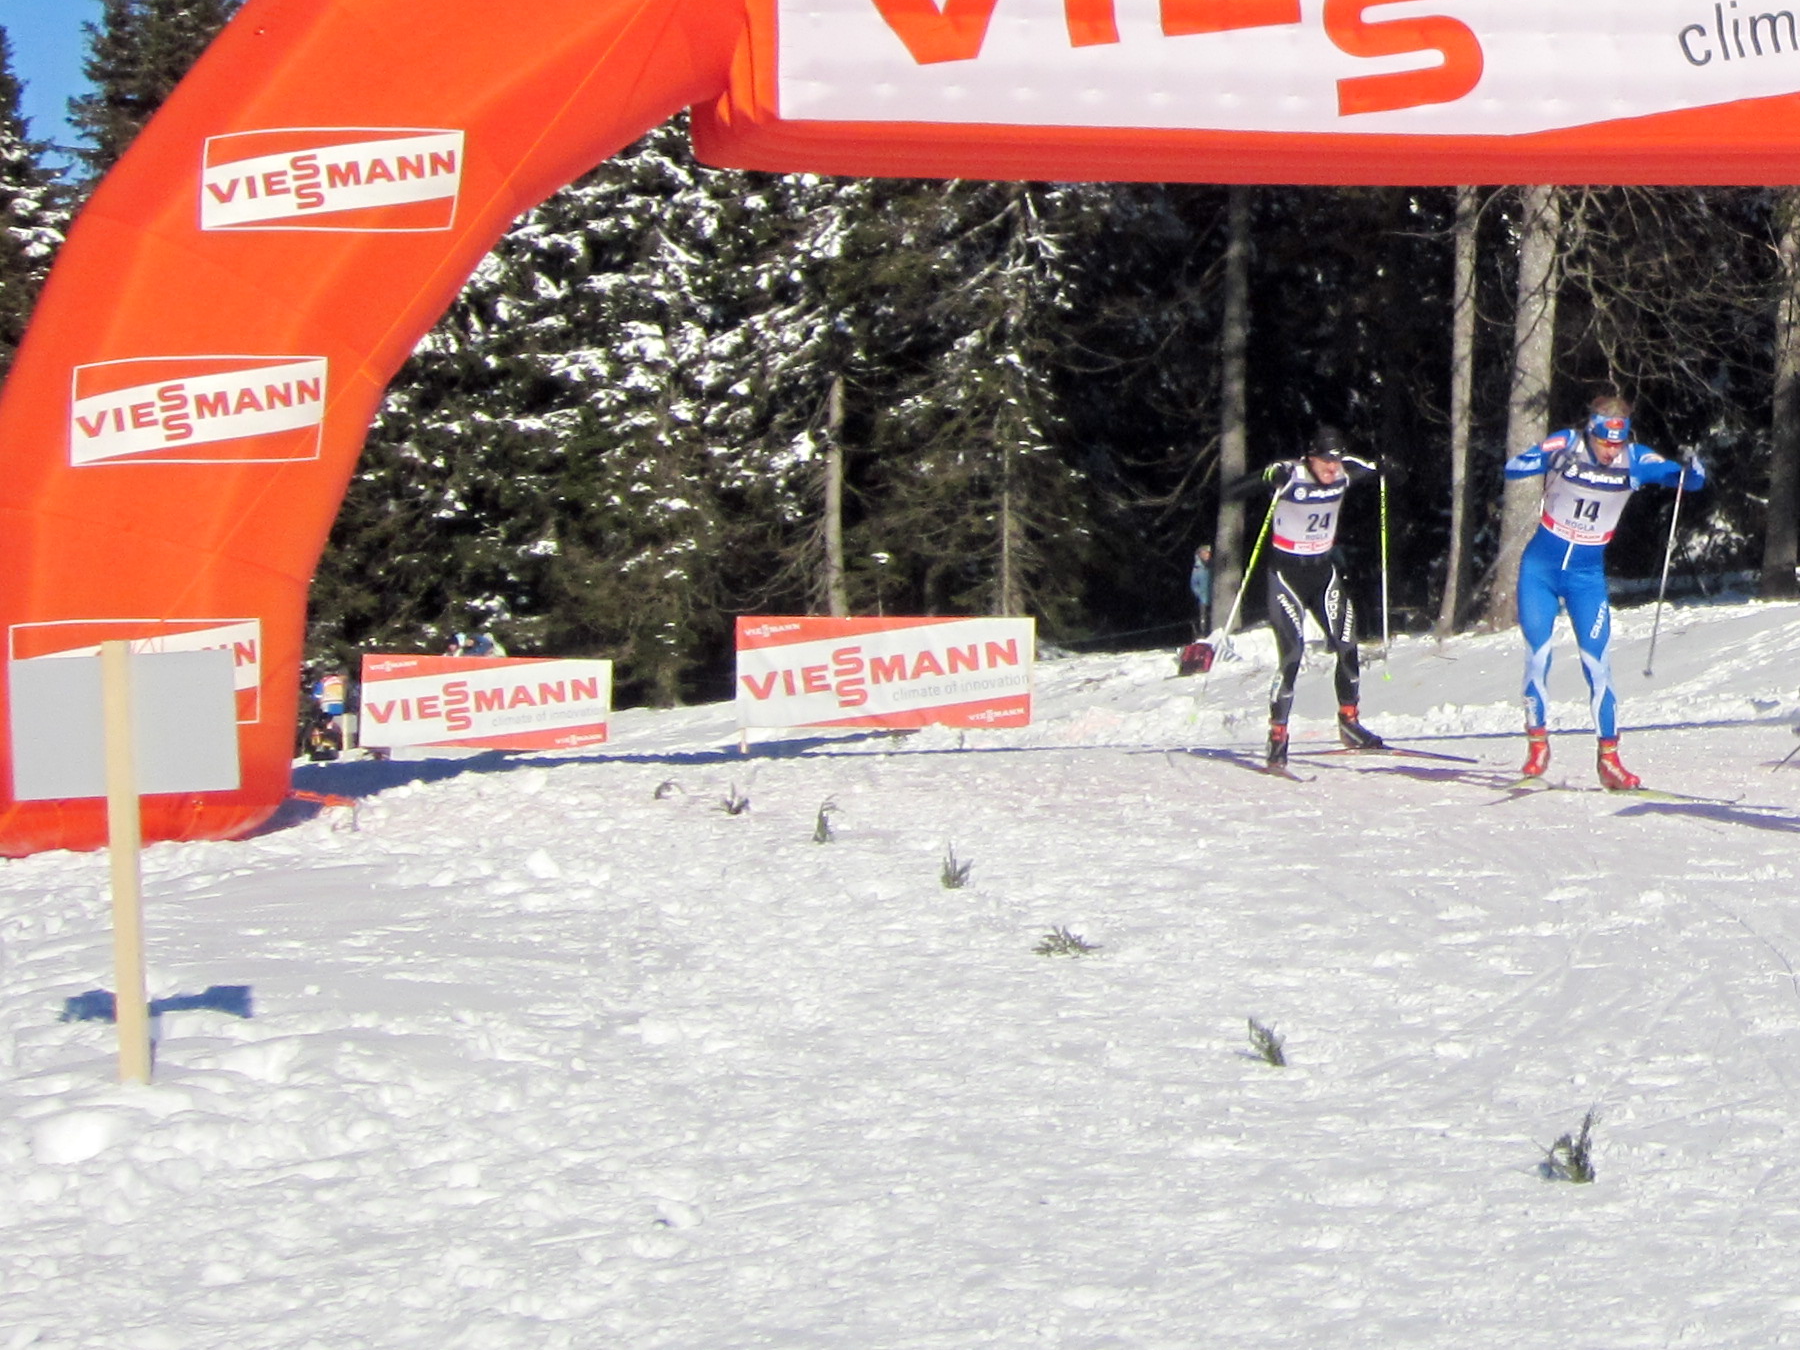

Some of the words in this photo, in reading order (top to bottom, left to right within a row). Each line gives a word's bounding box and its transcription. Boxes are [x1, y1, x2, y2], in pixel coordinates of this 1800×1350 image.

[206, 149, 456, 210] VIESSMANN
[75, 377, 321, 441] VIESSMANN
[1579, 470, 1625, 485] alpina
[1305, 512, 1331, 533] 24
[1573, 497, 1601, 523] 14
[740, 638, 1019, 708] VIESSMANN
[893, 685, 941, 702] climate
[944, 681, 958, 695] of
[961, 674, 1030, 693] innovation
[365, 676, 599, 731] VIESSMANN
